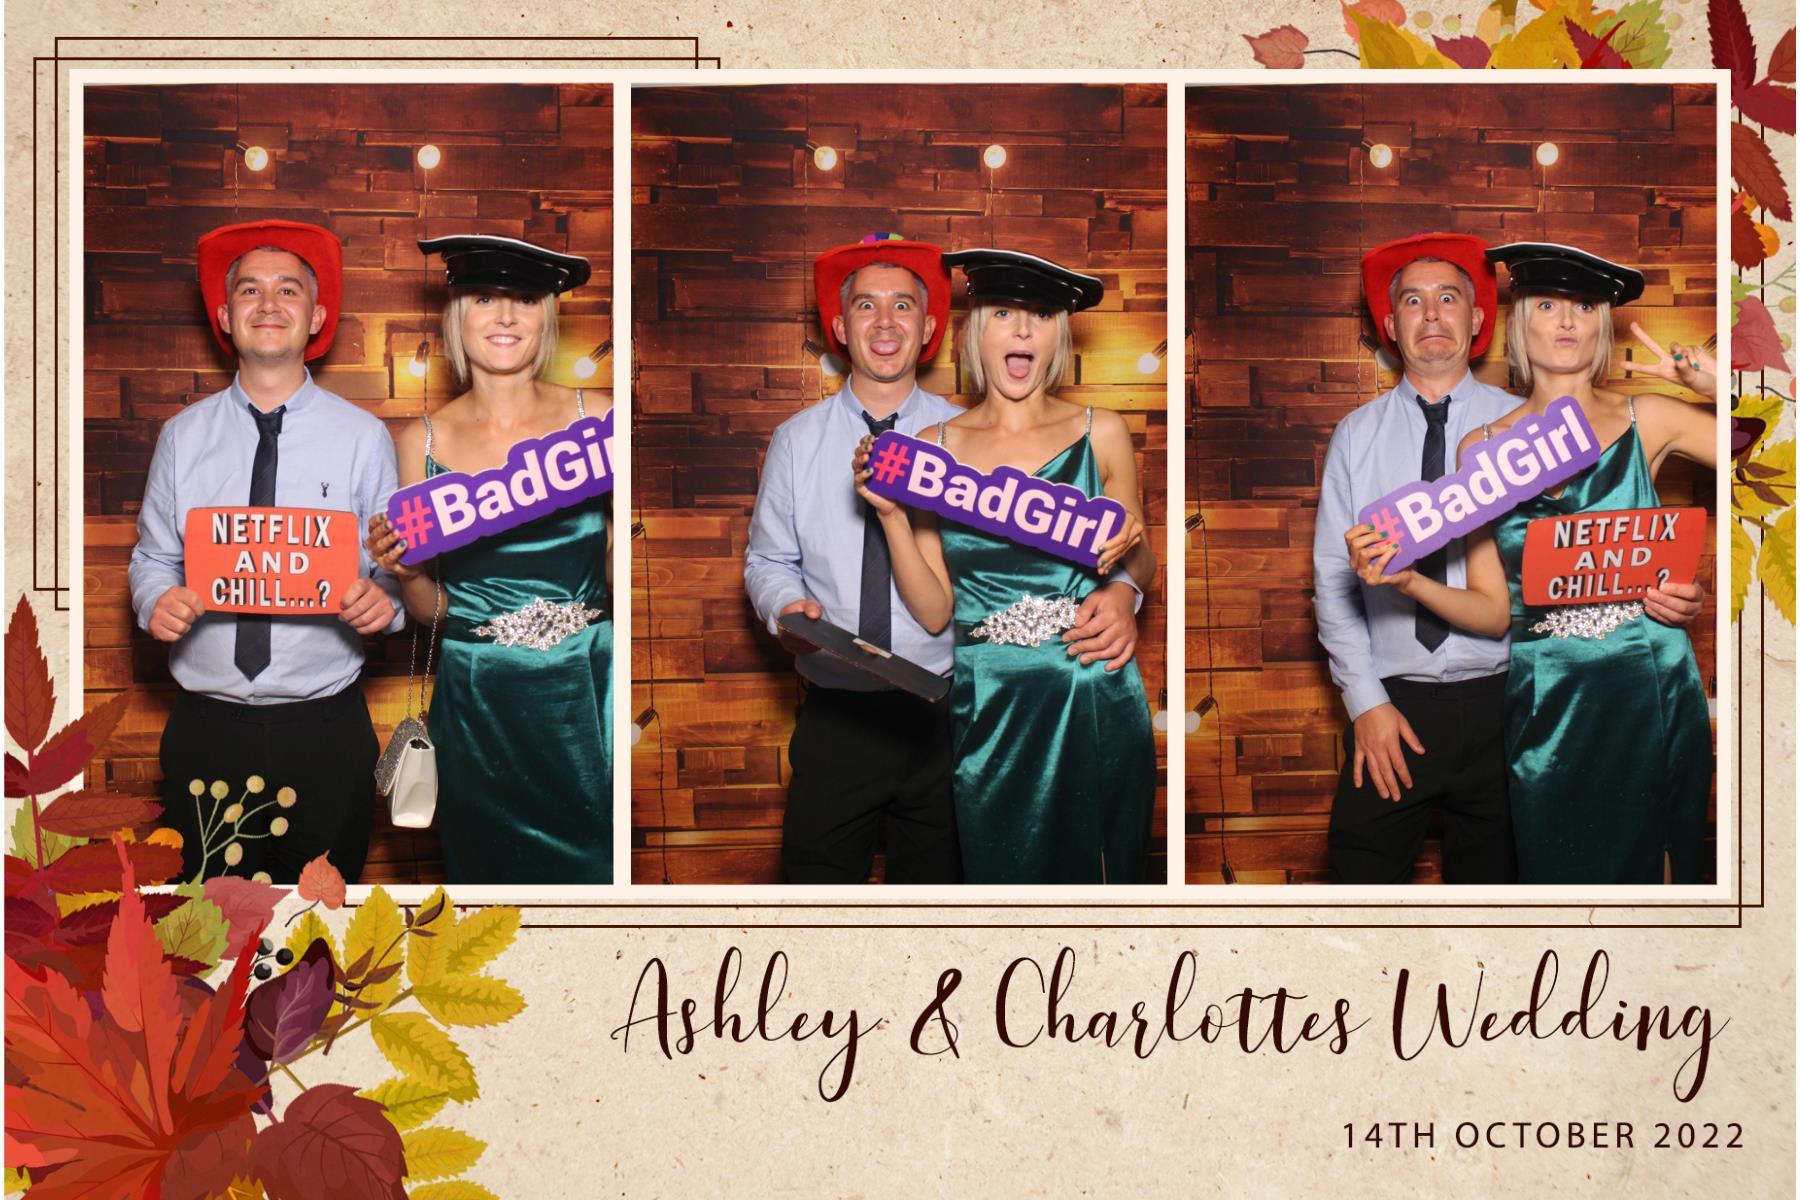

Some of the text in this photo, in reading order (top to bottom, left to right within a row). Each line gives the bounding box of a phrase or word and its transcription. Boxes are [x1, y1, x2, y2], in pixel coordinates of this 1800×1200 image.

[872, 440, 1117, 555] #BadGirl
[1370, 404, 1592, 555] #BadGirl
[211, 512, 332, 548] NETFLIX
[1553, 512, 1680, 549] NETFLIX
[233, 550, 310, 574] AND
[1573, 547, 1653, 571] AND
[211, 577, 332, 608] CHILL...?
